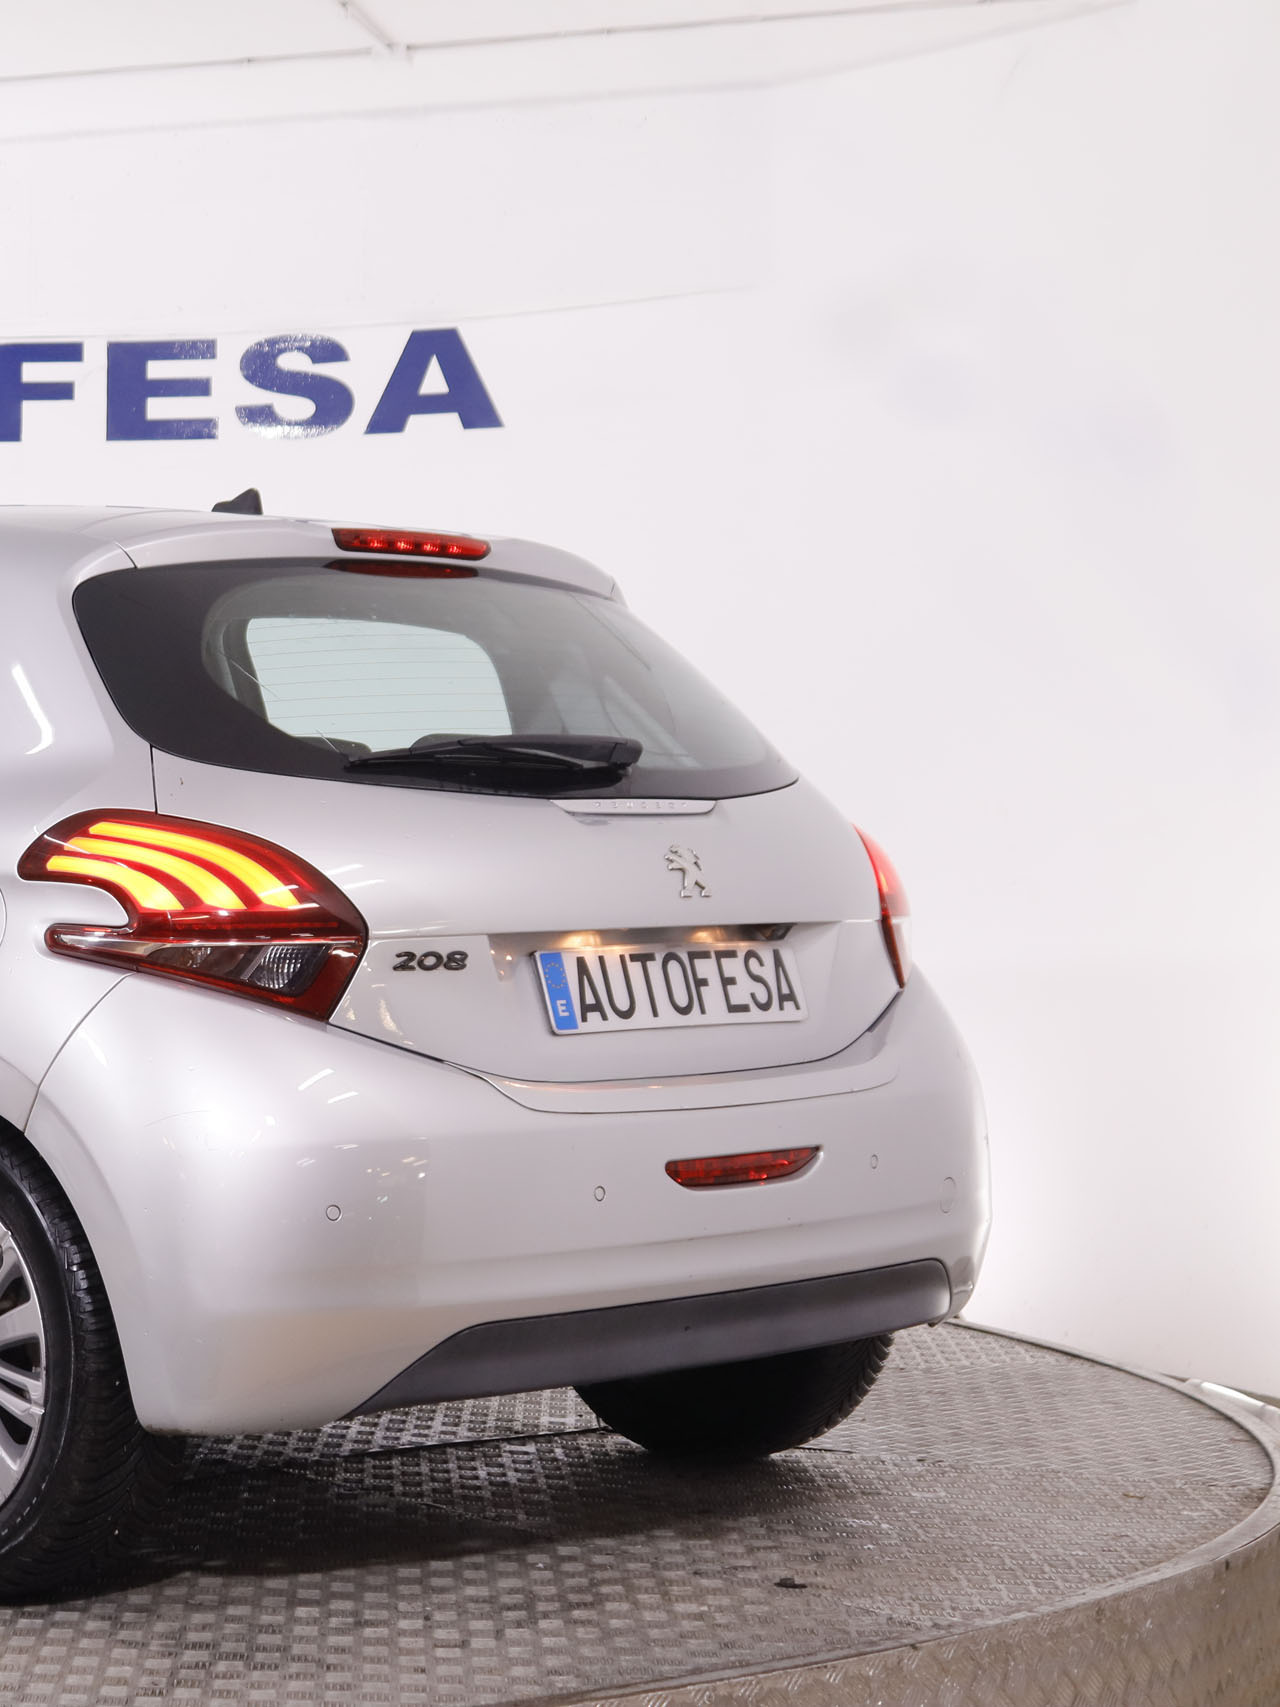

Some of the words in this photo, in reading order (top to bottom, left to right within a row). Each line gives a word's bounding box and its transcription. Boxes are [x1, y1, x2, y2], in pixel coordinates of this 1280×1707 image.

[392, 950, 470, 972] 208
[576, 948, 801, 1023] AUTOFESA
[555, 999, 570, 1017] E
